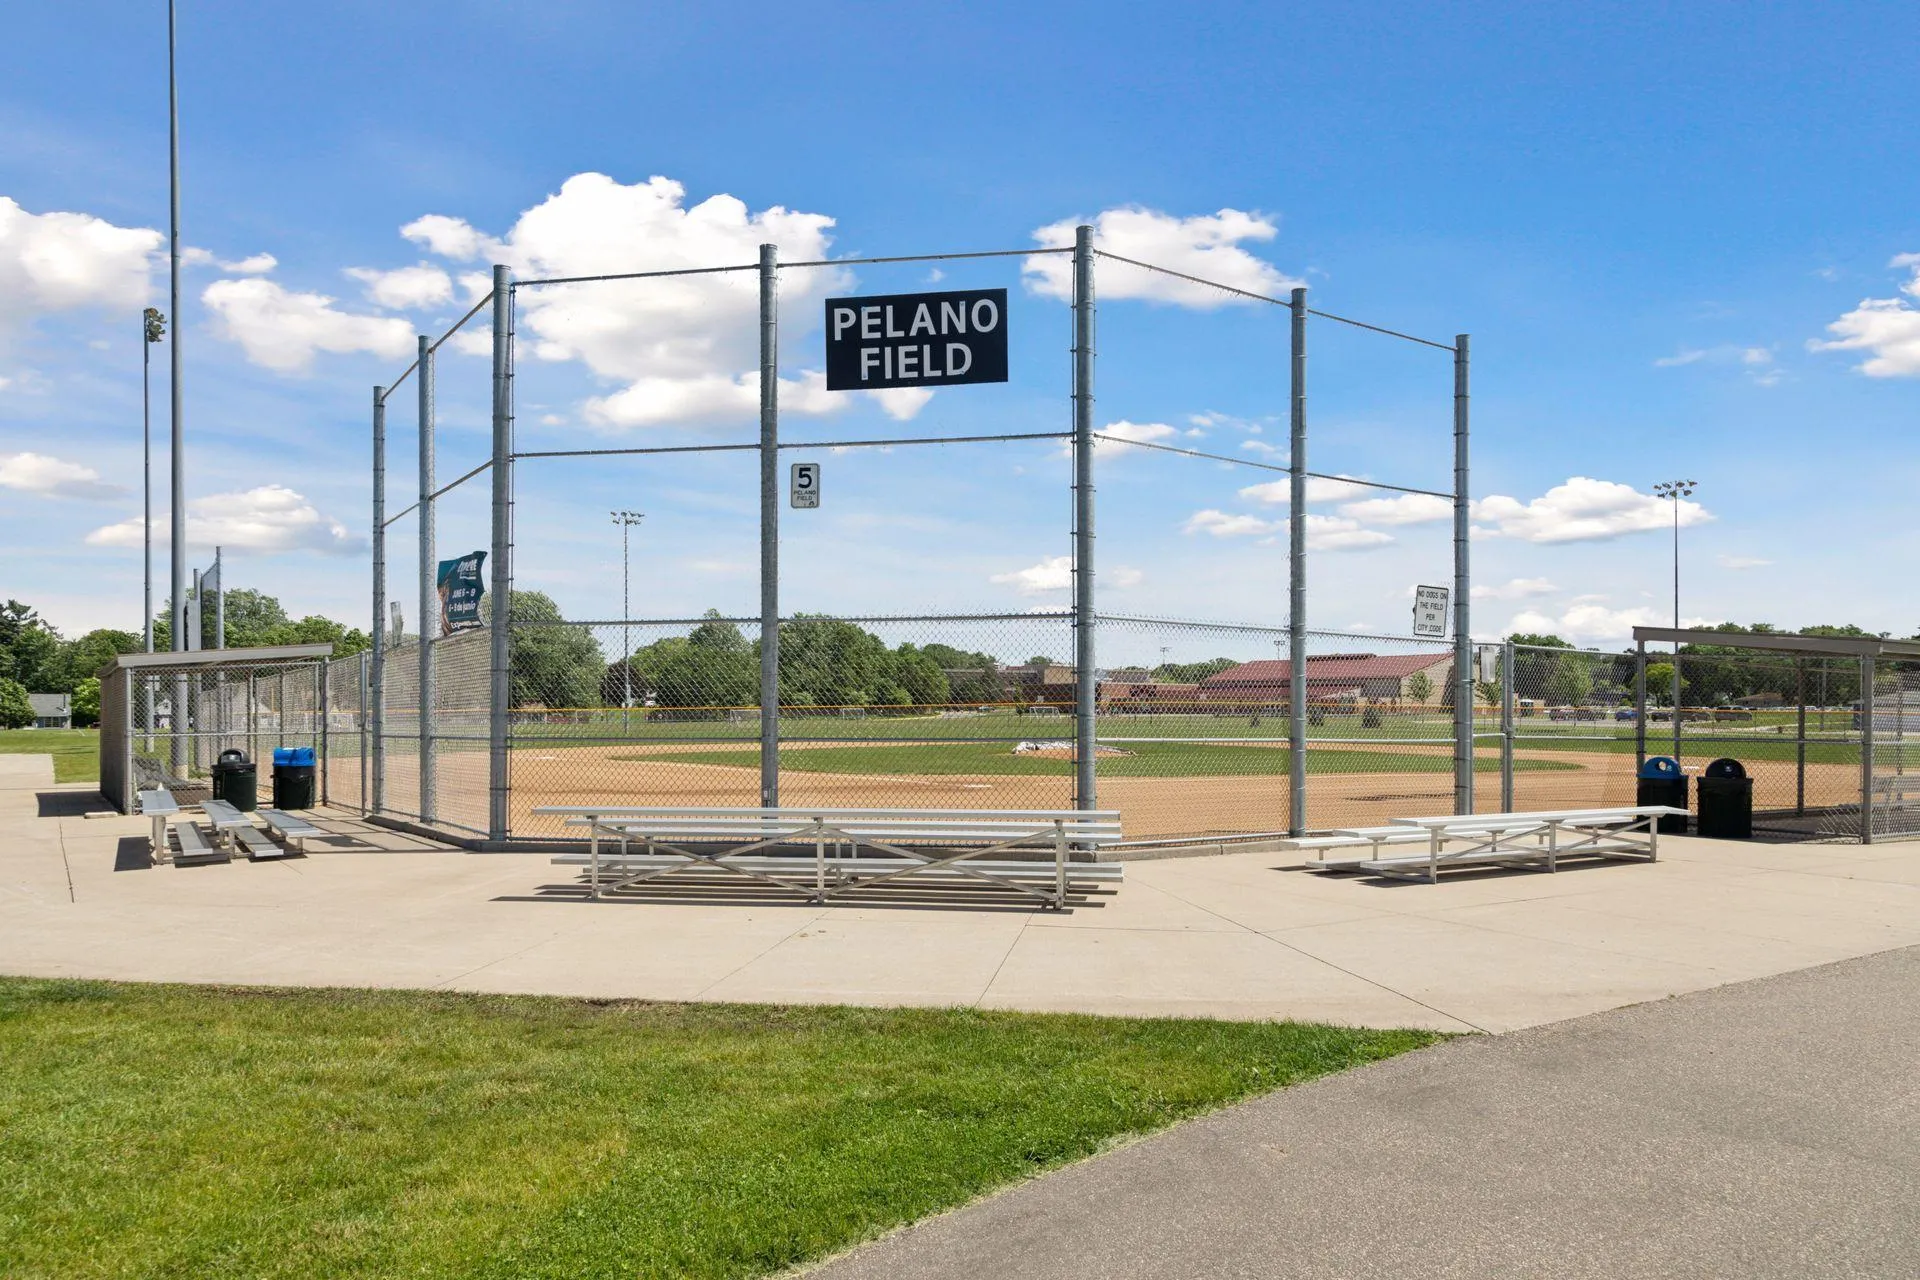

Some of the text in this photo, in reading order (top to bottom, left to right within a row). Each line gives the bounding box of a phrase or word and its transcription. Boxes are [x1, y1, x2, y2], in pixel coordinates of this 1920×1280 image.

[833, 298, 999, 341] PELANO
[860, 342, 972, 381] FIELD
[798, 467, 812, 489] 5
[1418, 590, 1447, 600] NO DOGS ON
